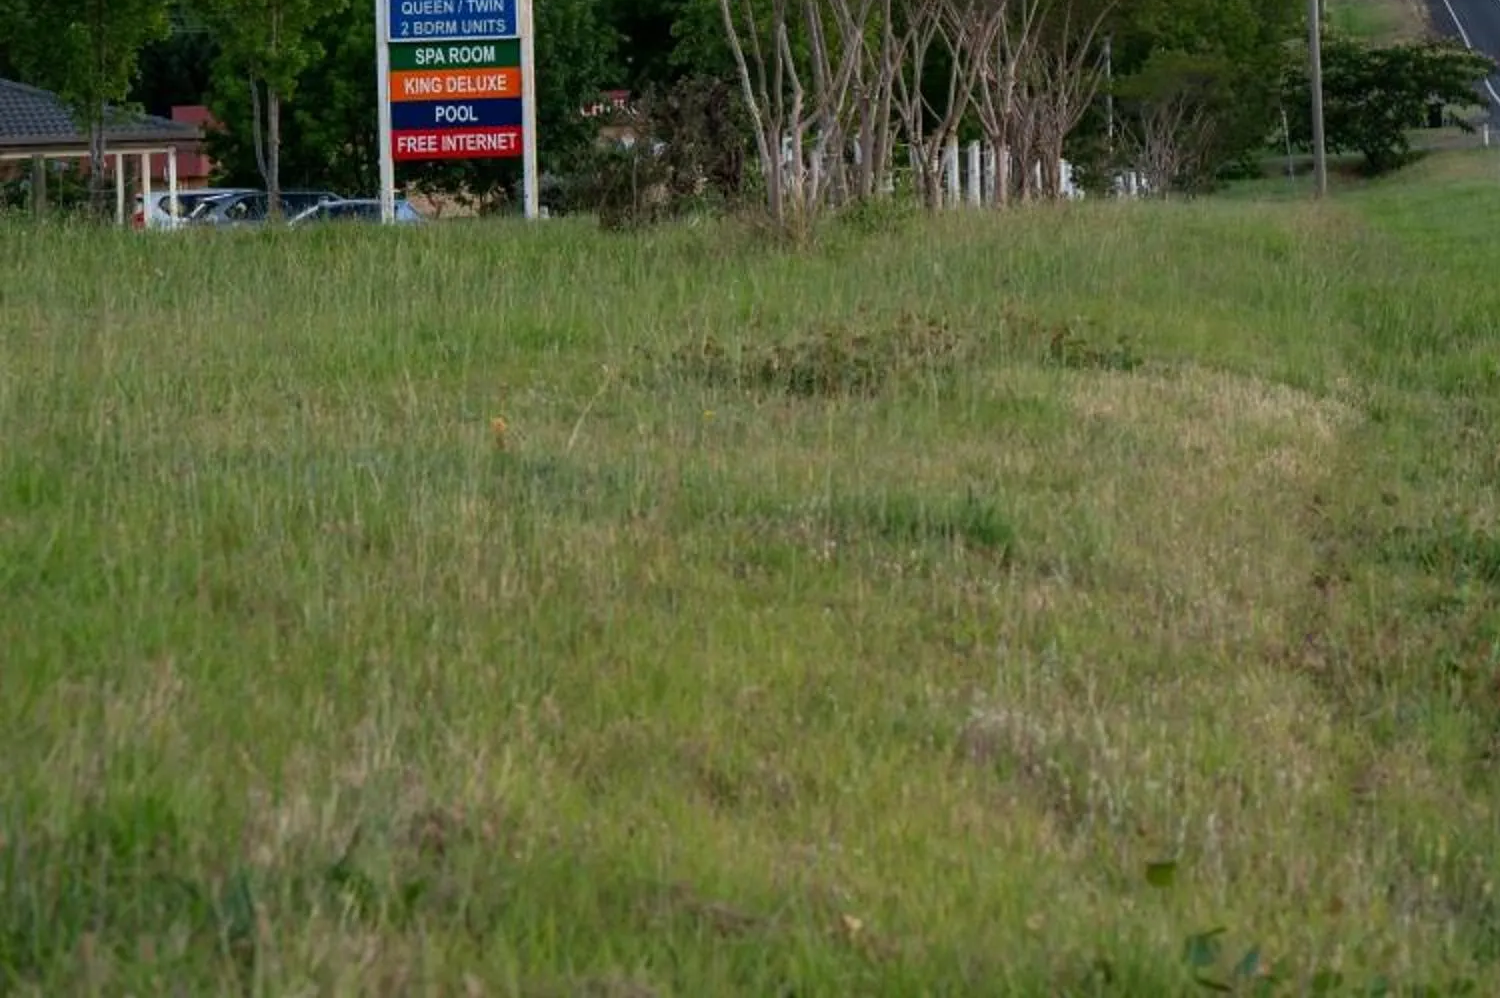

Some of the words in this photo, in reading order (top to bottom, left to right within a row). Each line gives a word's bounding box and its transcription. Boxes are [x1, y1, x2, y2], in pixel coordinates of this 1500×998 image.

[401, 0, 454, 15] QUEEN
[401, 21, 409, 35] 2
[413, 20, 457, 35] BDRM
[461, 18, 506, 33] UNITS
[415, 47, 445, 64] SPA
[449, 45, 495, 63] ROOM
[403, 76, 443, 94] KING
[446, 73, 507, 92] DELUXE
[435, 105, 479, 122] POOL
[397, 135, 437, 153] FREE
[441, 132, 517, 151] INTERNET
